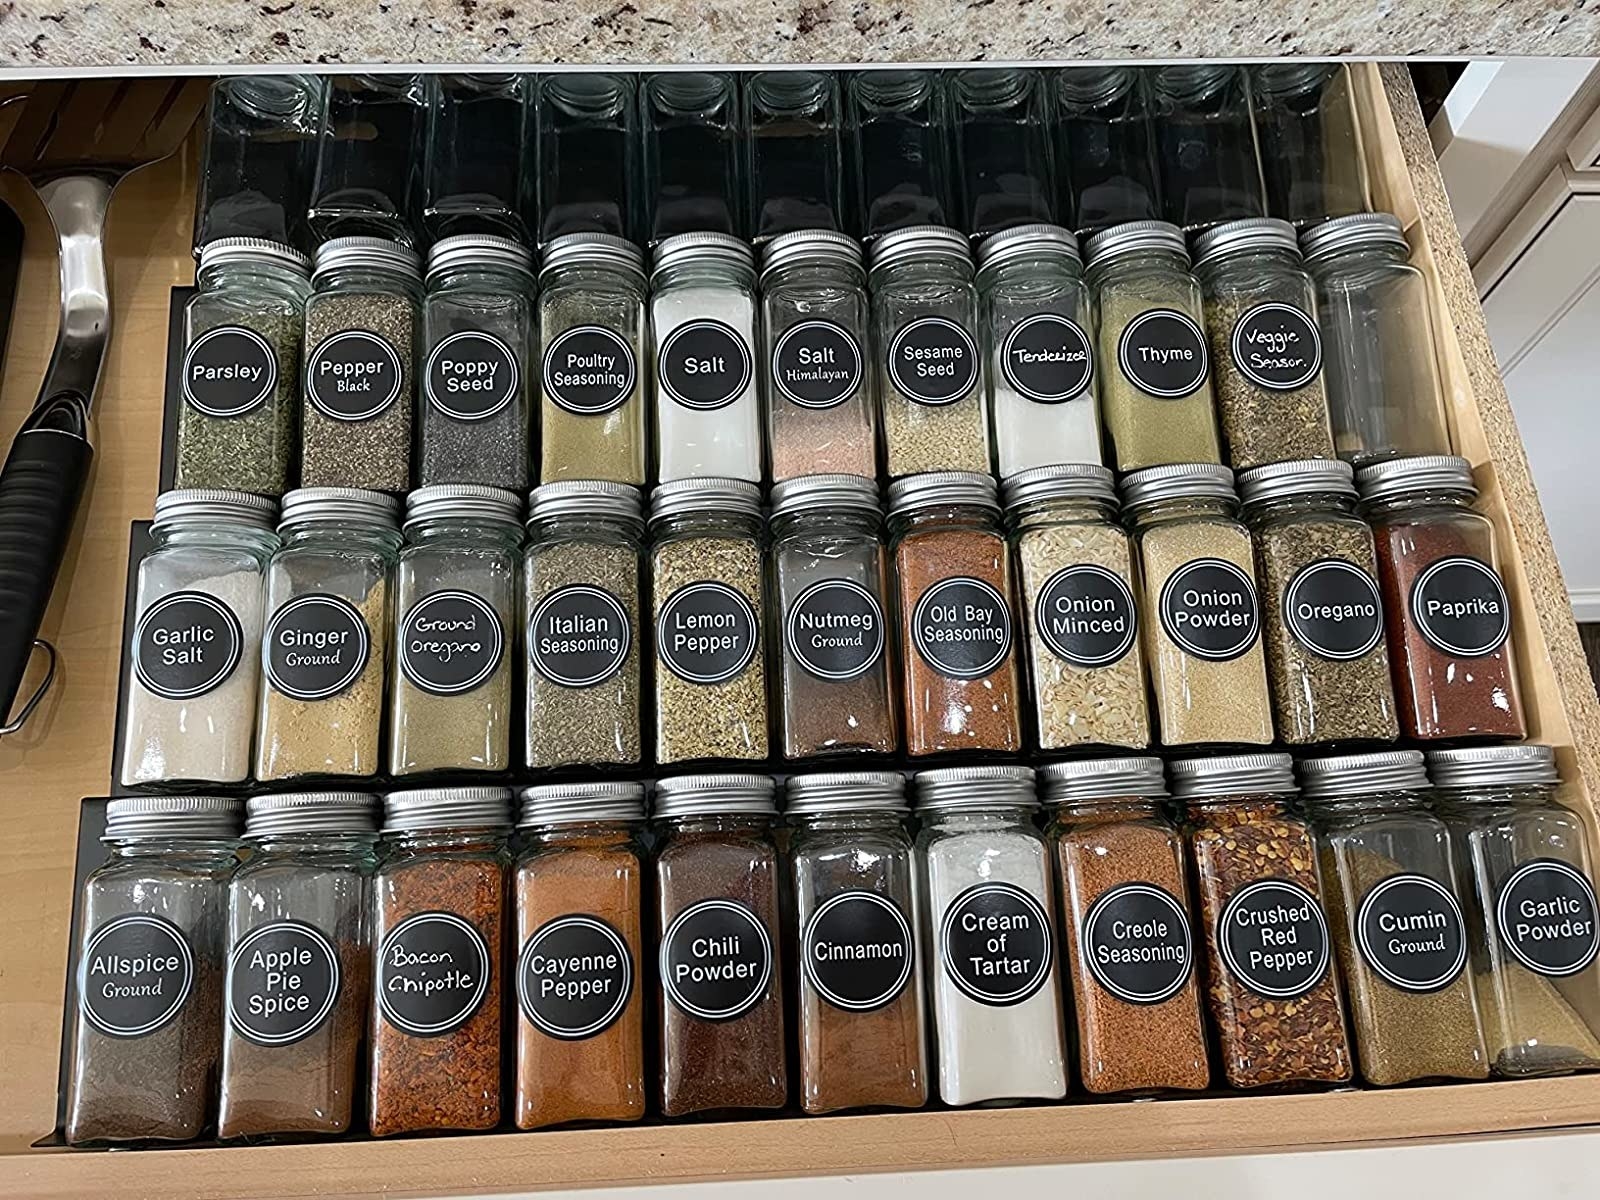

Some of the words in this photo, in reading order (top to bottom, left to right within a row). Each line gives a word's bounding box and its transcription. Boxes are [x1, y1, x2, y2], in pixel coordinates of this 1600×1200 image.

[1246, 325, 1299, 353] Veggie
[568, 354, 615, 371] Poultry
[799, 347, 835, 364] Salt
[904, 346, 962, 360] Sesame
[1138, 347, 1193, 364] Thyme
[193, 364, 262, 381] Parsley
[321, 361, 384, 378] Pepper
[442, 360, 498, 376] Poppy
[685, 357, 725, 374] Salt
[786, 366, 849, 383] Himalayan
[917, 362, 954, 377] Seed
[337, 378, 370, 392] Black
[447, 376, 493, 392] Seed
[554, 371, 625, 388] Seasoning
[1056, 596, 1115, 613] Onion
[1183, 589, 1242, 607] Onion
[931, 605, 957, 623] Old
[965, 605, 993, 628] Bay
[1298, 603, 1375, 621] Oregano
[1427, 598, 1499, 618] Paprika
[415, 614, 476, 632] Ground
[550, 615, 608, 634] Italian
[676, 612, 735, 629] Lemon
[800, 613, 872, 630] Nutmeg
[1053, 616, 1124, 634] Minced
[1175, 610, 1250, 628] Powder
[153, 626, 214, 645] Garlic
[280, 629, 348, 649] Ginger
[811, 631, 863, 648] Ground
[924, 624, 1003, 644] Seasoning
[541, 635, 618, 654] Seasoning
[675, 634, 739, 654] Pepper
[162, 647, 203, 665] Salt
[286, 649, 340, 666] Ground
[1236, 903, 1310, 926] Crushed
[1520, 896, 1580, 918] Garlic
[962, 913, 1029, 932] Cream
[1113, 919, 1167, 939] Creole
[1379, 913, 1446, 932] Cumin
[1517, 919, 1591, 942] Powder
[987, 933, 1006, 953] of
[1261, 926, 1296, 946] Red
[1388, 933, 1446, 954] Ground
[389, 944, 453, 967] Bacon
[692, 936, 739, 957] Chili
[815, 942, 902, 961] Cinnamon
[1098, 942, 1185, 964] Seasoning
[90, 953, 179, 977] Allspice
[249, 947, 312, 972] Apple
[531, 955, 617, 977] Cayenne
[970, 957, 1030, 975] Tartar
[1250, 950, 1313, 972] Pepper
[267, 971, 301, 991] Pie
[676, 960, 757, 983] Powder
[102, 977, 162, 998] Ground
[388, 970, 473, 996] Chipotle
[542, 979, 611, 1000] Pepper
[249, 993, 309, 1018] Spice
